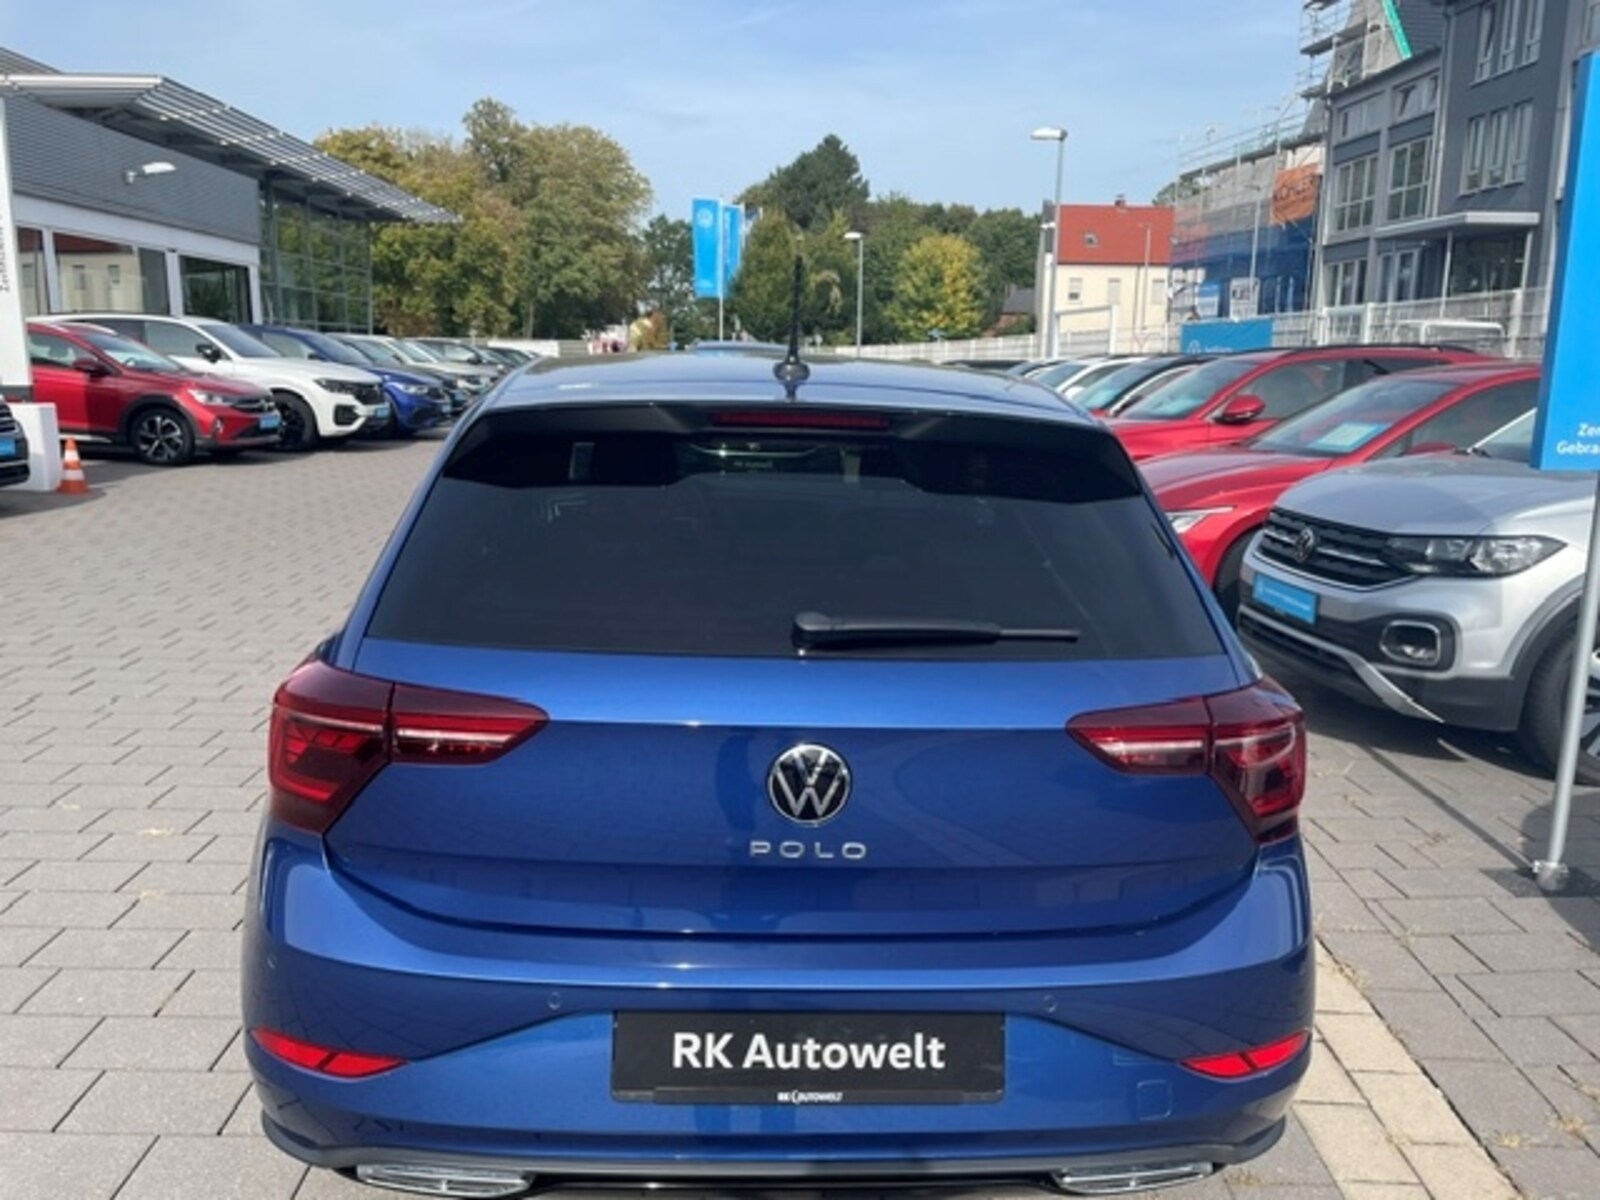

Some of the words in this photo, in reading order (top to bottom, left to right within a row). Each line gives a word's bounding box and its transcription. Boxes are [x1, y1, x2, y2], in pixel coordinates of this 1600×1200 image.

[750, 840, 867, 859] POLO
[672, 1032, 735, 1069] RK
[742, 1032, 946, 1070] Autowelt
